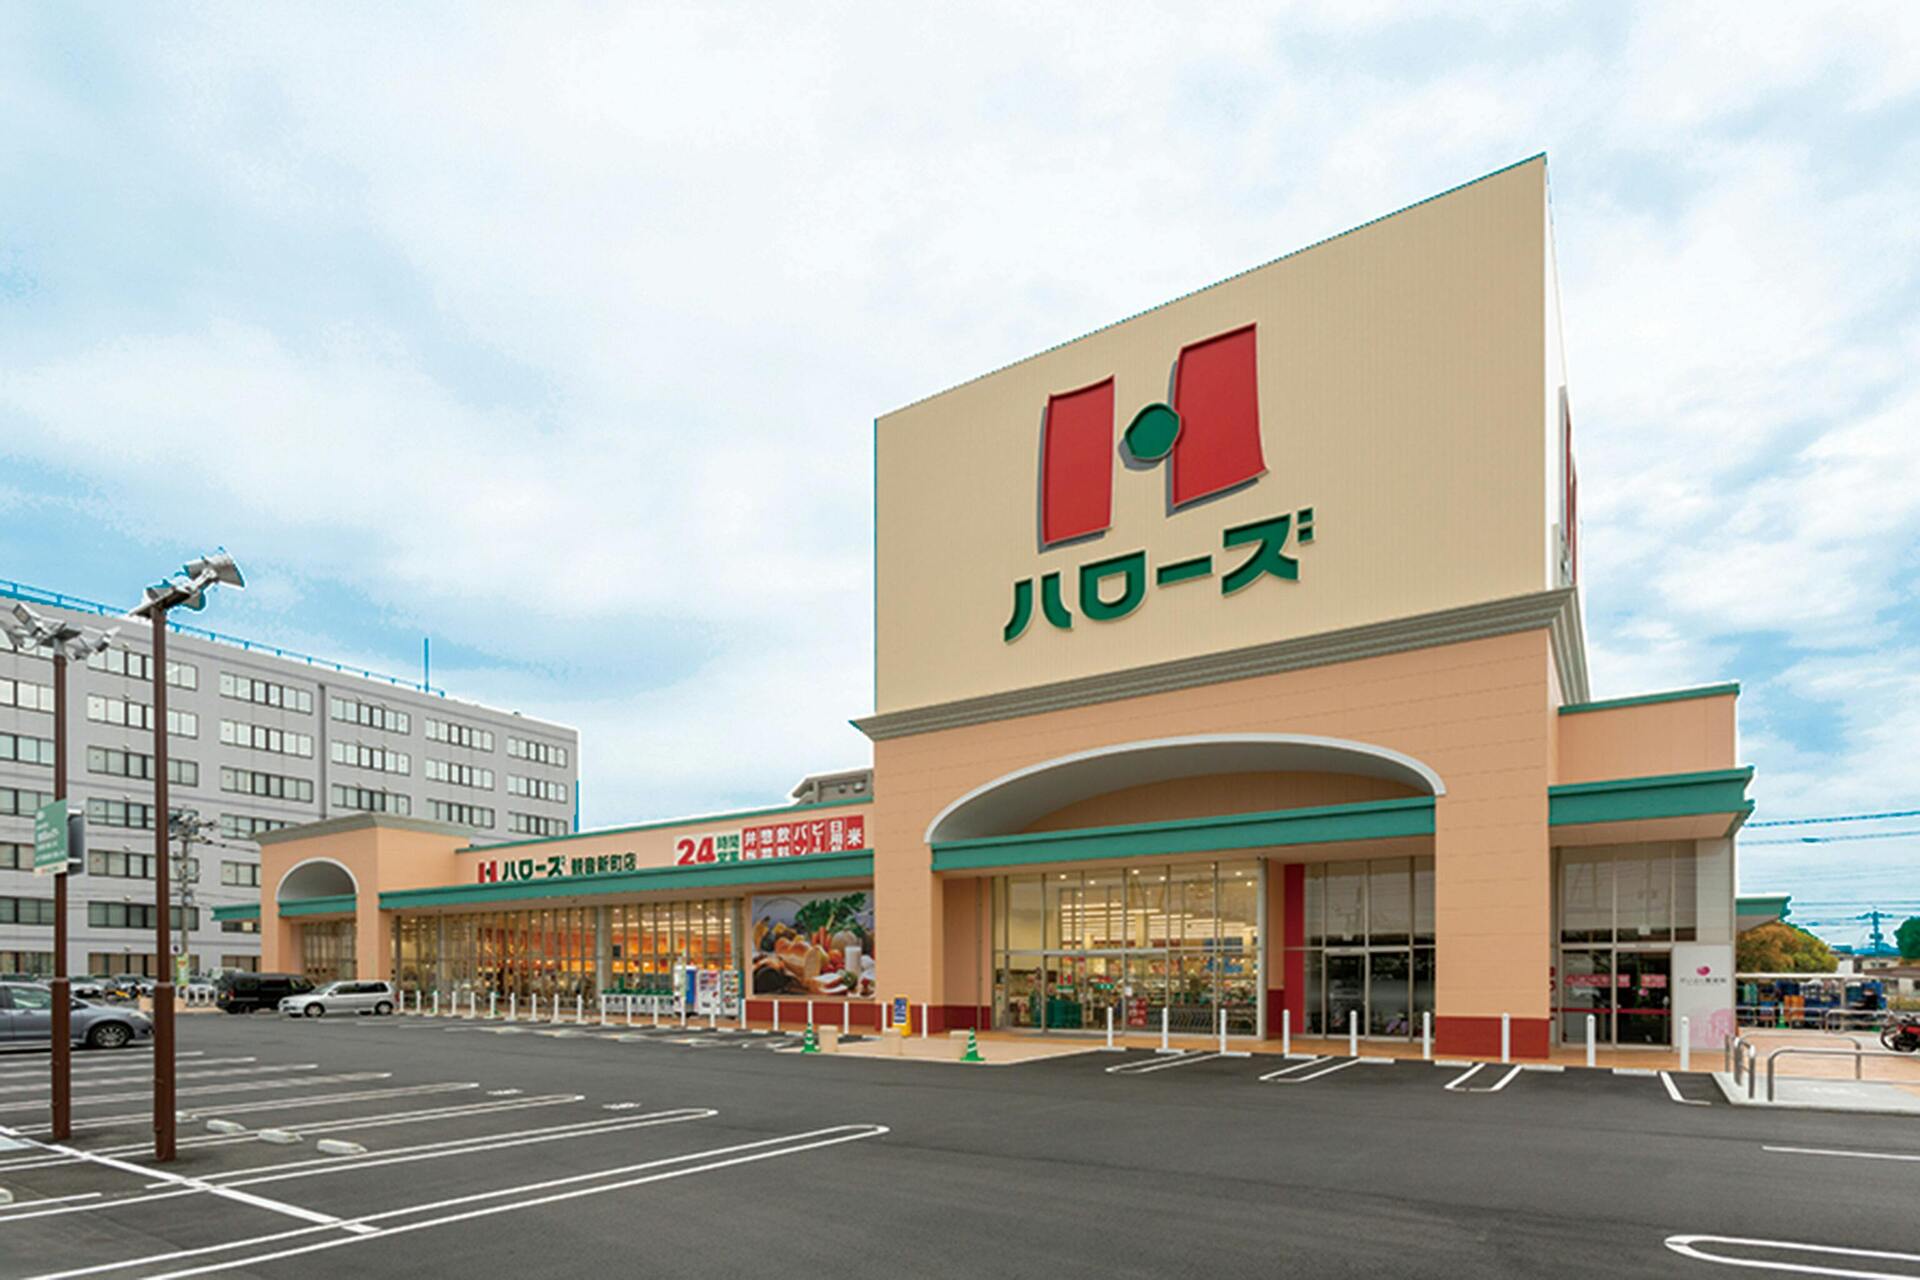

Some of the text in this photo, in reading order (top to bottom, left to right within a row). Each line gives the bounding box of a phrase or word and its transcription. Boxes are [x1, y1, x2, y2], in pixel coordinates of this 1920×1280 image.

[1003, 506, 1315, 643] ハローズ
[676, 836, 717, 866] 24
[793, 824, 808, 856] パン
[847, 827, 862, 848] 米
[501, 854, 566, 882] ハローズ
